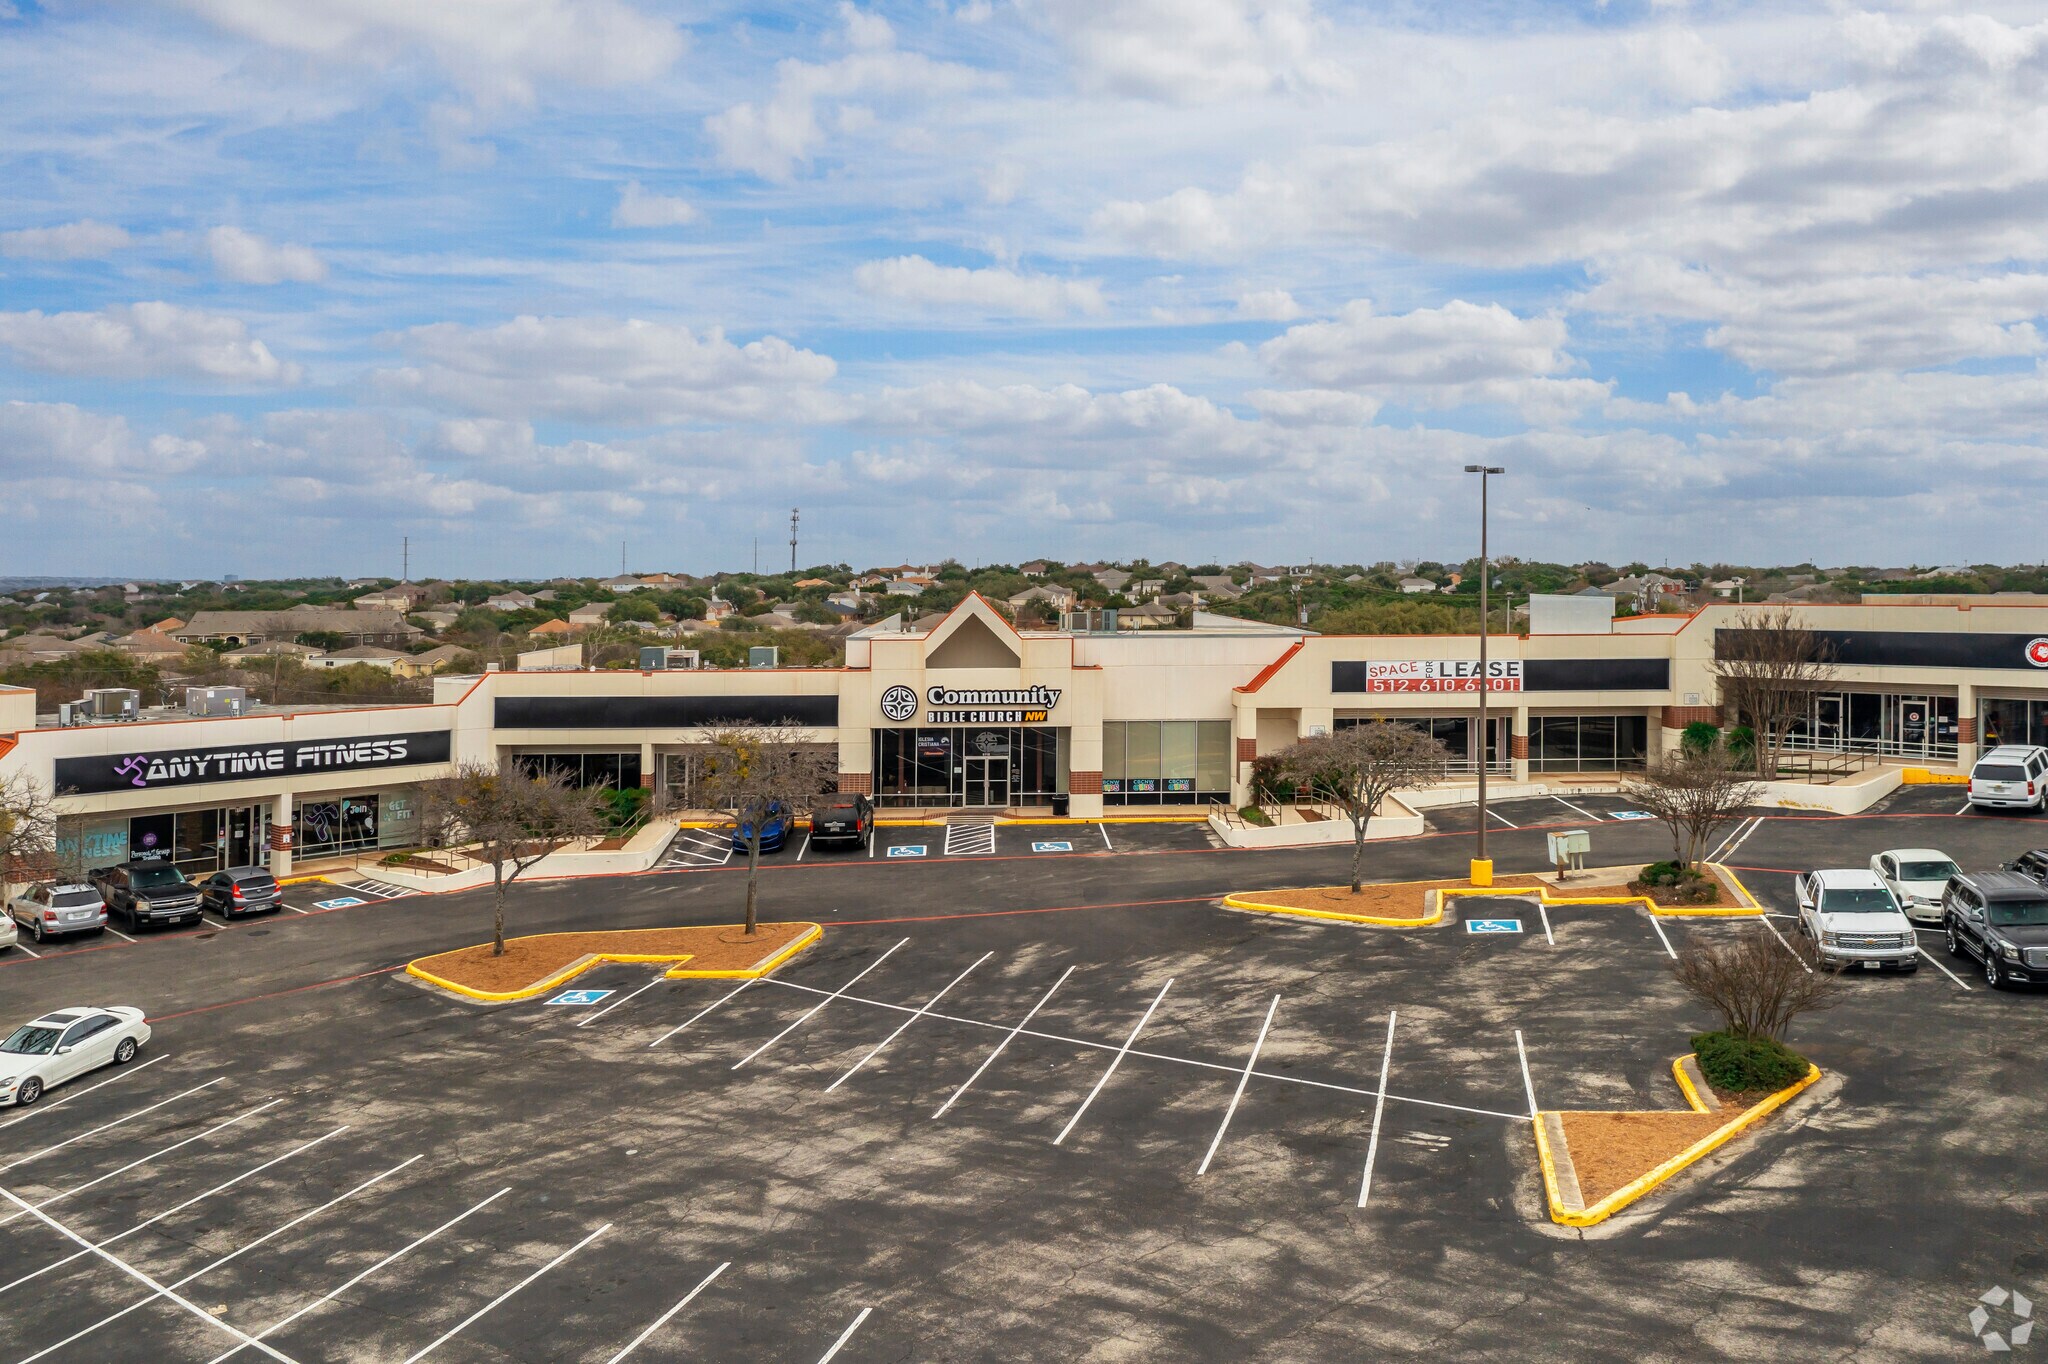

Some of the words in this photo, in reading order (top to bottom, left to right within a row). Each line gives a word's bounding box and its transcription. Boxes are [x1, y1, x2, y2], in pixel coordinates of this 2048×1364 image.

[1369, 661, 1419, 678] SPACE
[1425, 660, 1433, 679] FOR
[1439, 661, 1520, 678] LEASE
[927, 685, 1062, 709] Community
[928, 711, 966, 723] BIBLE
[970, 711, 1022, 723] CHURCH
[1025, 711, 1046, 721] NW
[145, 748, 285, 780] ANYTIME
[295, 739, 408, 768] FITNESS
[388, 799, 407, 811] GET
